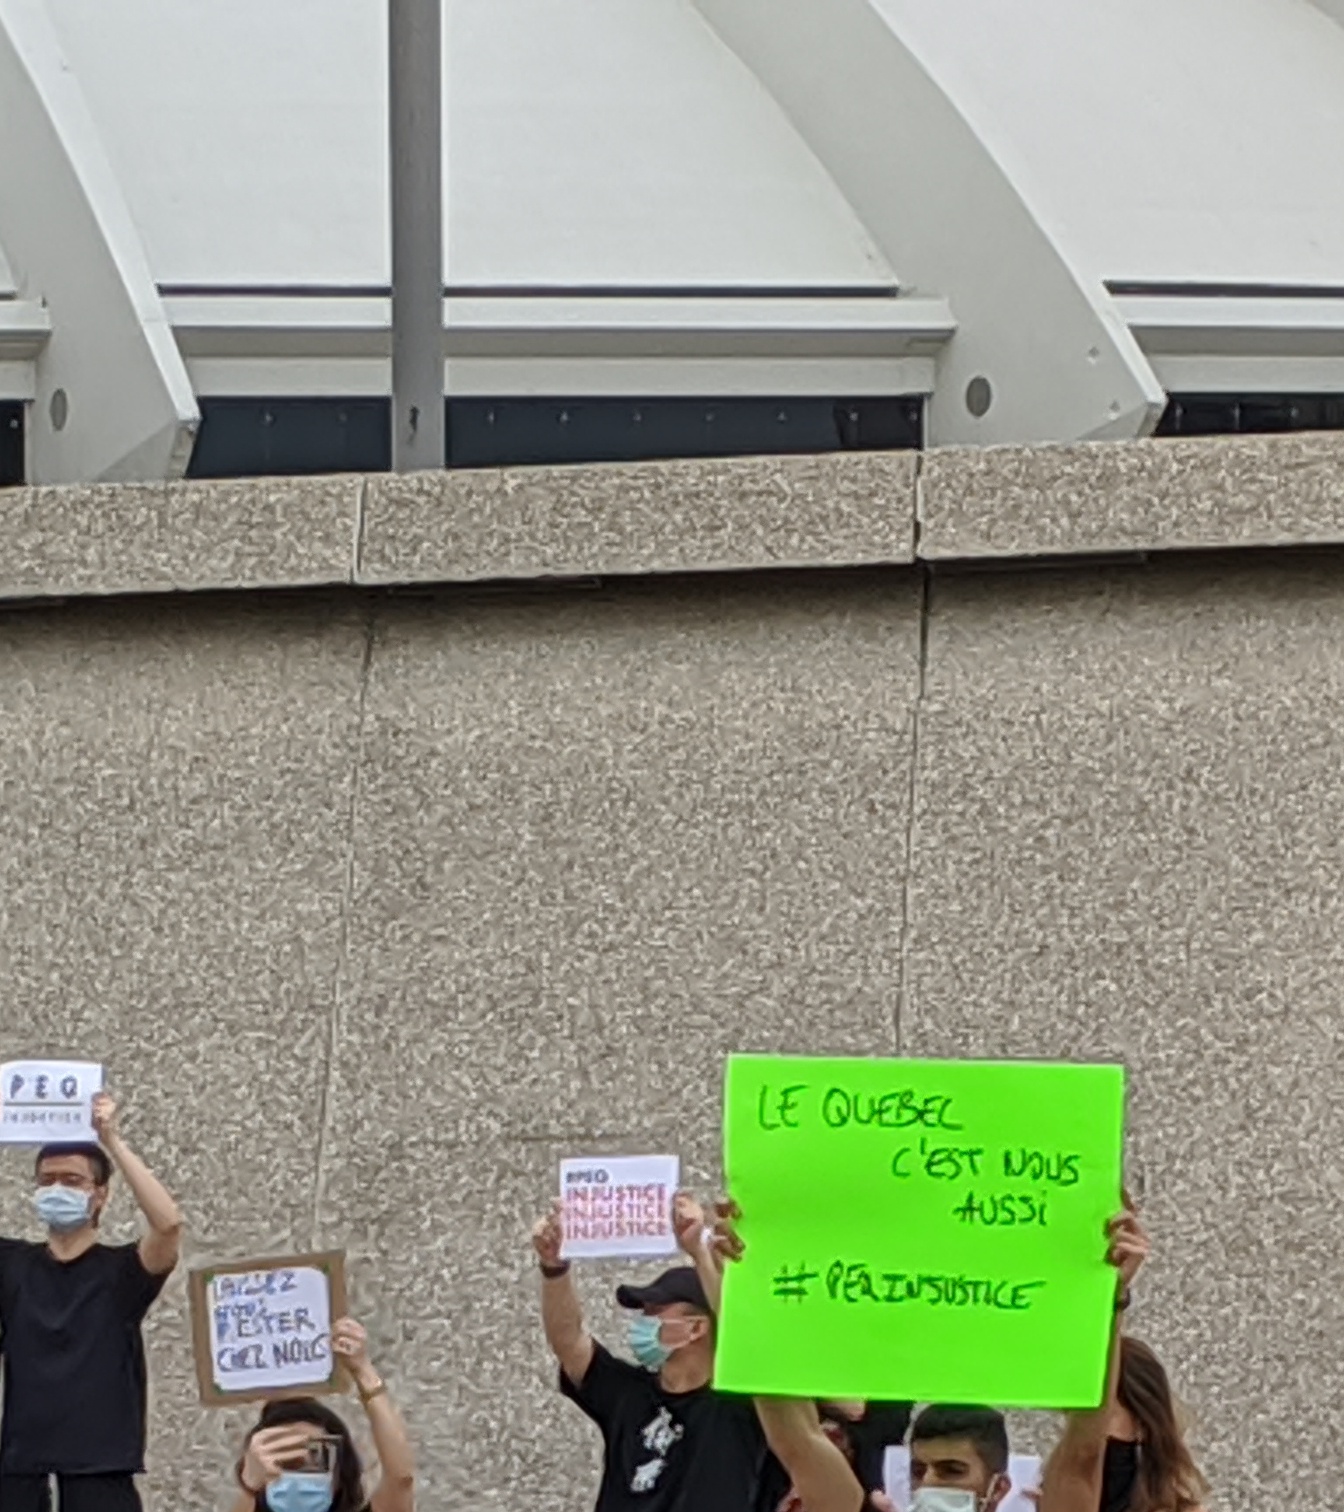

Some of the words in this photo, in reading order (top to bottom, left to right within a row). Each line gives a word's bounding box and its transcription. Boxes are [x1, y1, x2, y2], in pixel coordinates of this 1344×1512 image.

[10, 1074, 78, 1099] PEQ
[759, 1084, 810, 1130] LE
[823, 1087, 963, 1131] QUEBEC
[892, 1137, 985, 1180] C'EST
[1004, 1150, 1082, 1186] NOUS
[567, 1220, 666, 1240] INJUSTICE
